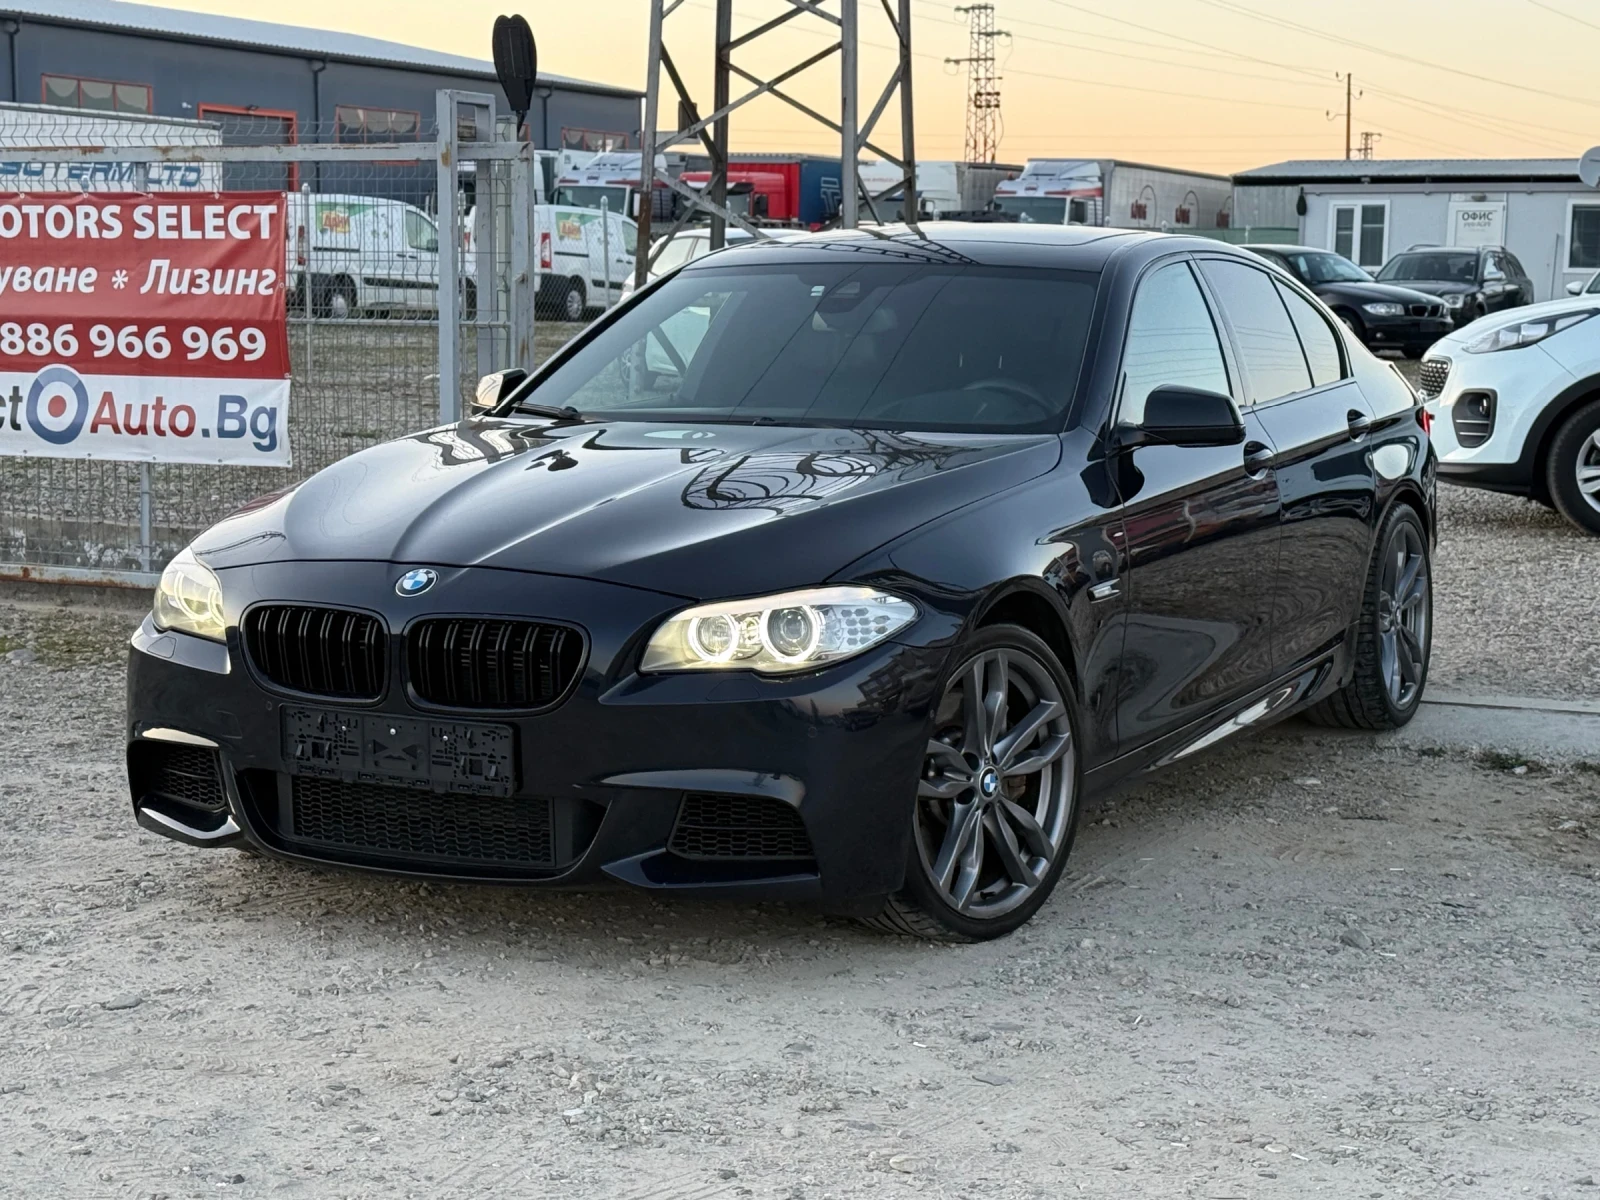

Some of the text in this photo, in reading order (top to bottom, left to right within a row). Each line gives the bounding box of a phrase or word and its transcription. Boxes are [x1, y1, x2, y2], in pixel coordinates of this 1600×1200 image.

[0, 204, 278, 240] OTORS SELECT
[1461, 211, 1493, 221] ОФИС
[140, 258, 277, 296] Лизинг
[0, 321, 267, 362] 886 966 969
[90, 391, 278, 452] Auto.Bg
